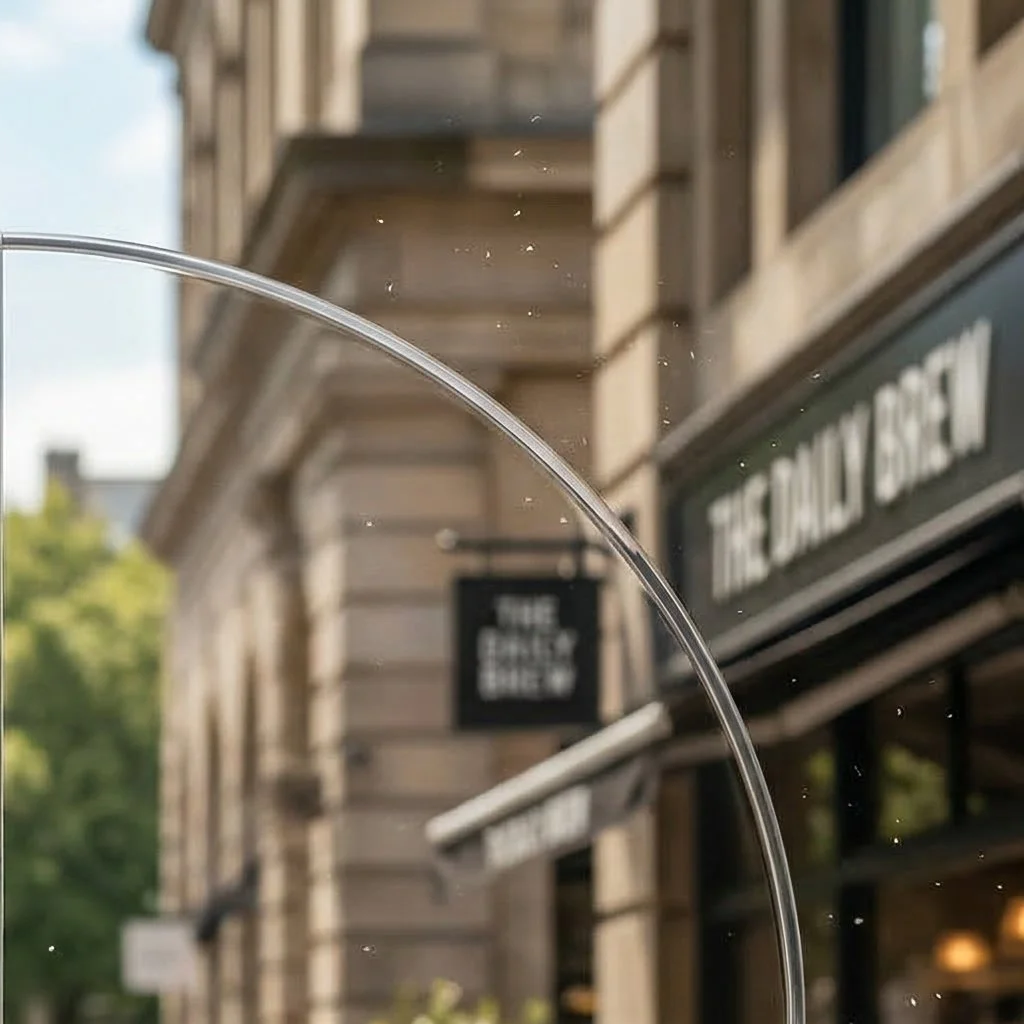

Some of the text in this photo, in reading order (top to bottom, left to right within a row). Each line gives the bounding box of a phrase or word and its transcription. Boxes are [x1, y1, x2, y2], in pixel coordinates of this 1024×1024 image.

[708, 317, 992, 602] THE DAILY BREW
[496, 594, 556, 628] THE
